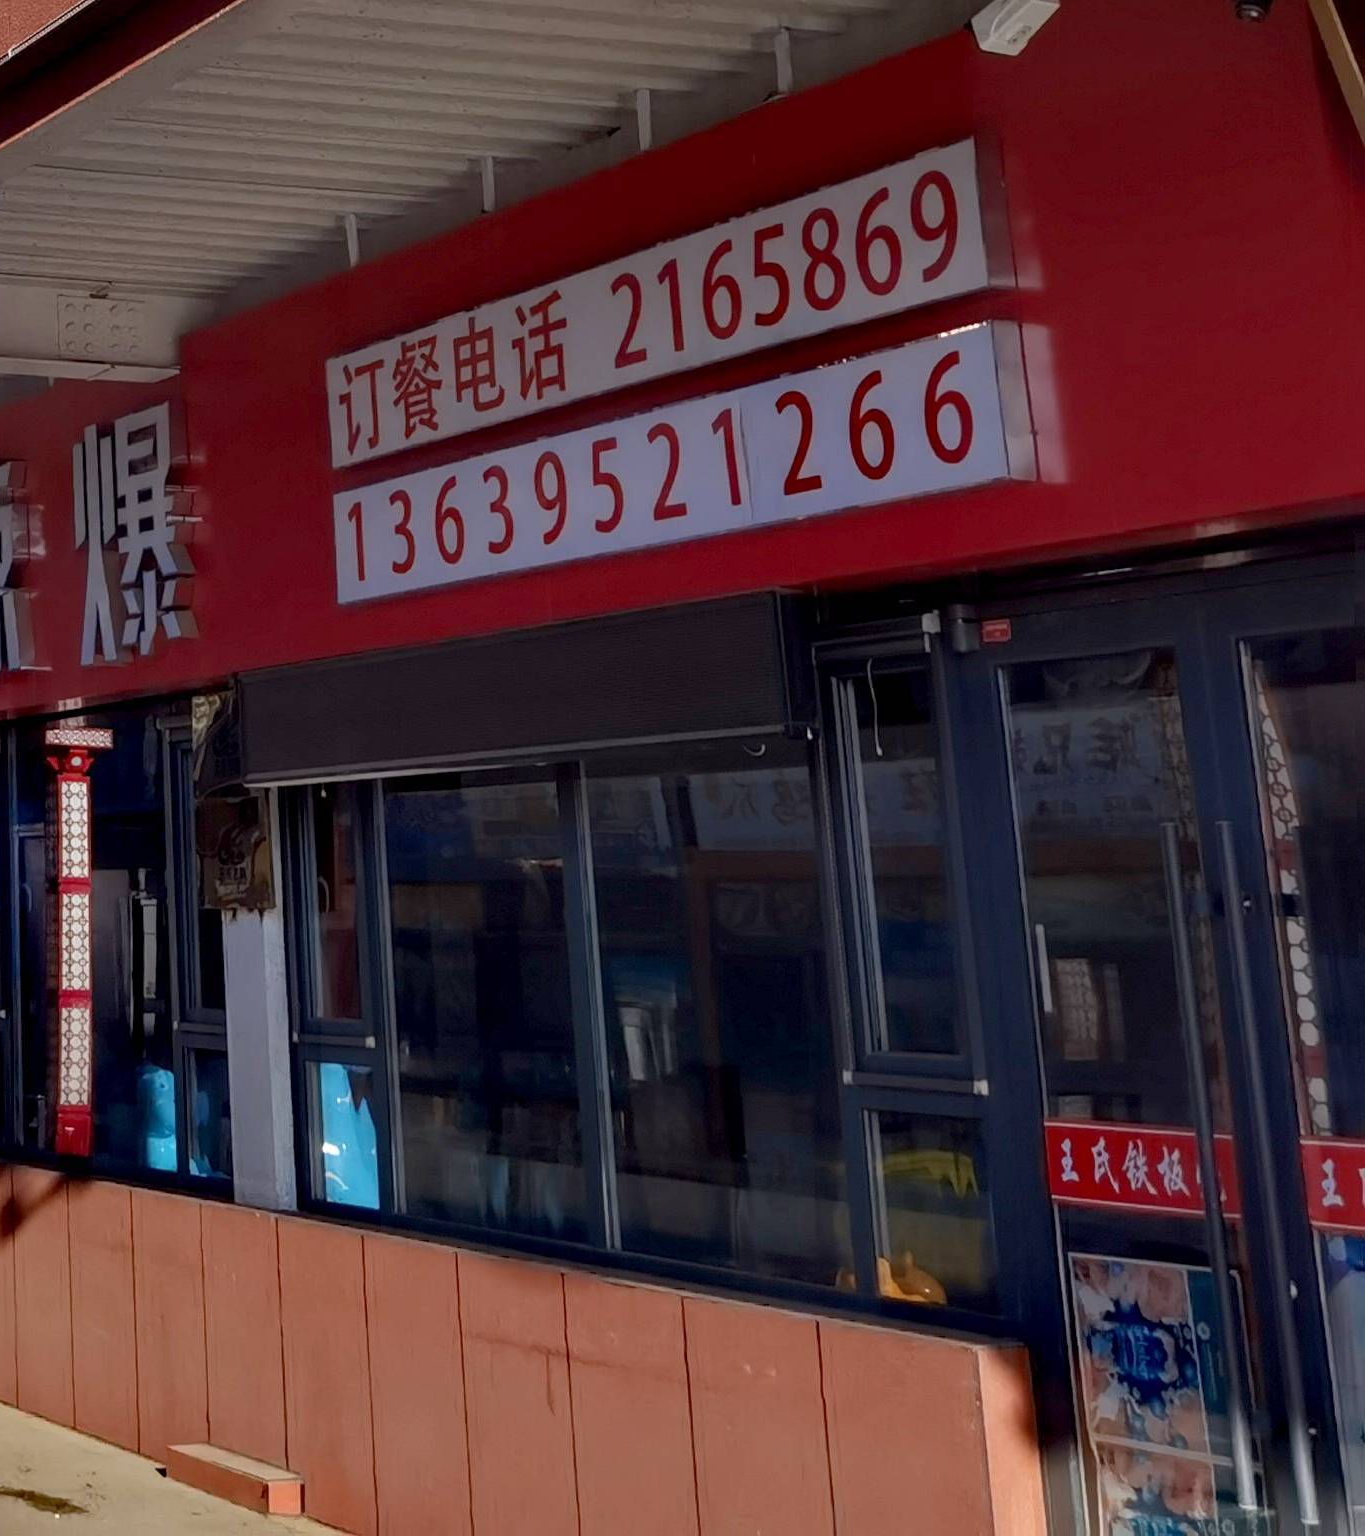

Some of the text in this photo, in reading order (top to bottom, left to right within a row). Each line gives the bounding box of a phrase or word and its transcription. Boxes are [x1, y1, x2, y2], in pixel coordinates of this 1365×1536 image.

[337, 169, 960, 459] 订餐电话 2165869
[346, 348, 976, 584] 13639521266
